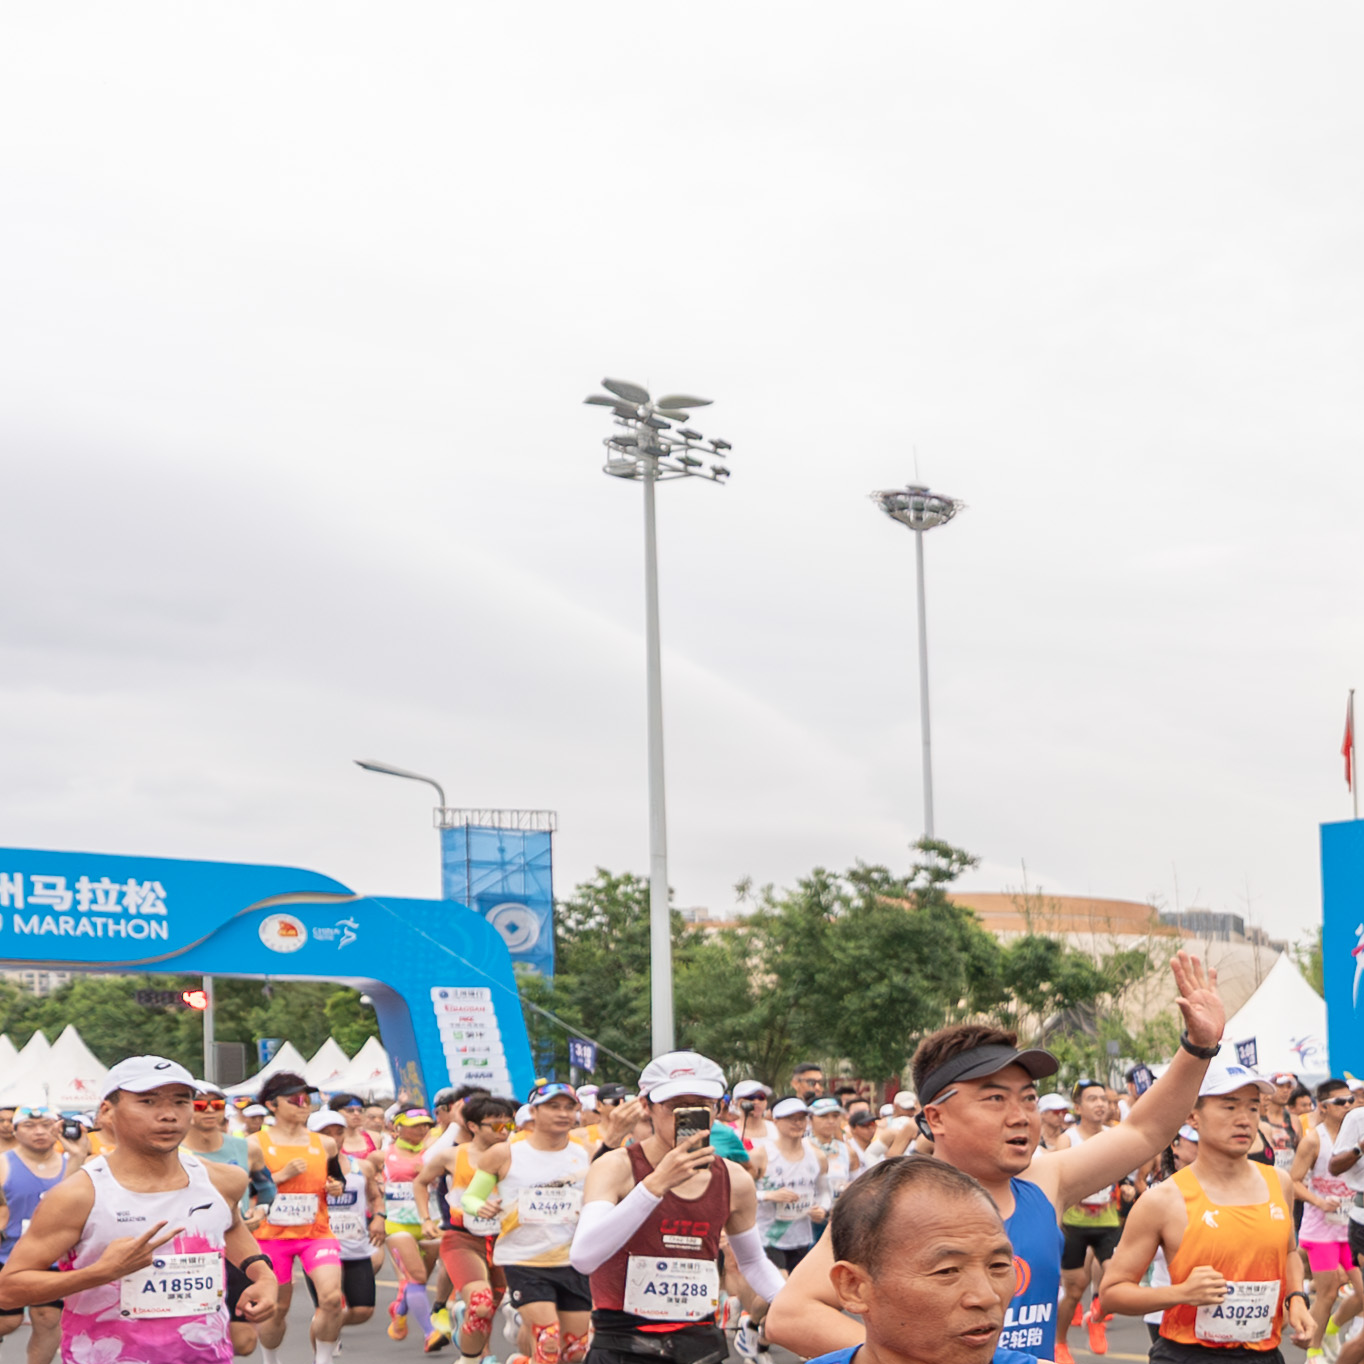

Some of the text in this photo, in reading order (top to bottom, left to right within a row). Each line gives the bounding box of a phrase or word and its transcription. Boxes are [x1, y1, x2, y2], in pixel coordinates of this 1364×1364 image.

[13, 914, 169, 940] MARATHON
[141, 1276, 213, 1294] A18550
[643, 1281, 708, 1297] A31288
[1003, 1302, 1053, 1327] LUN
[1212, 1304, 1270, 1319] A30238
